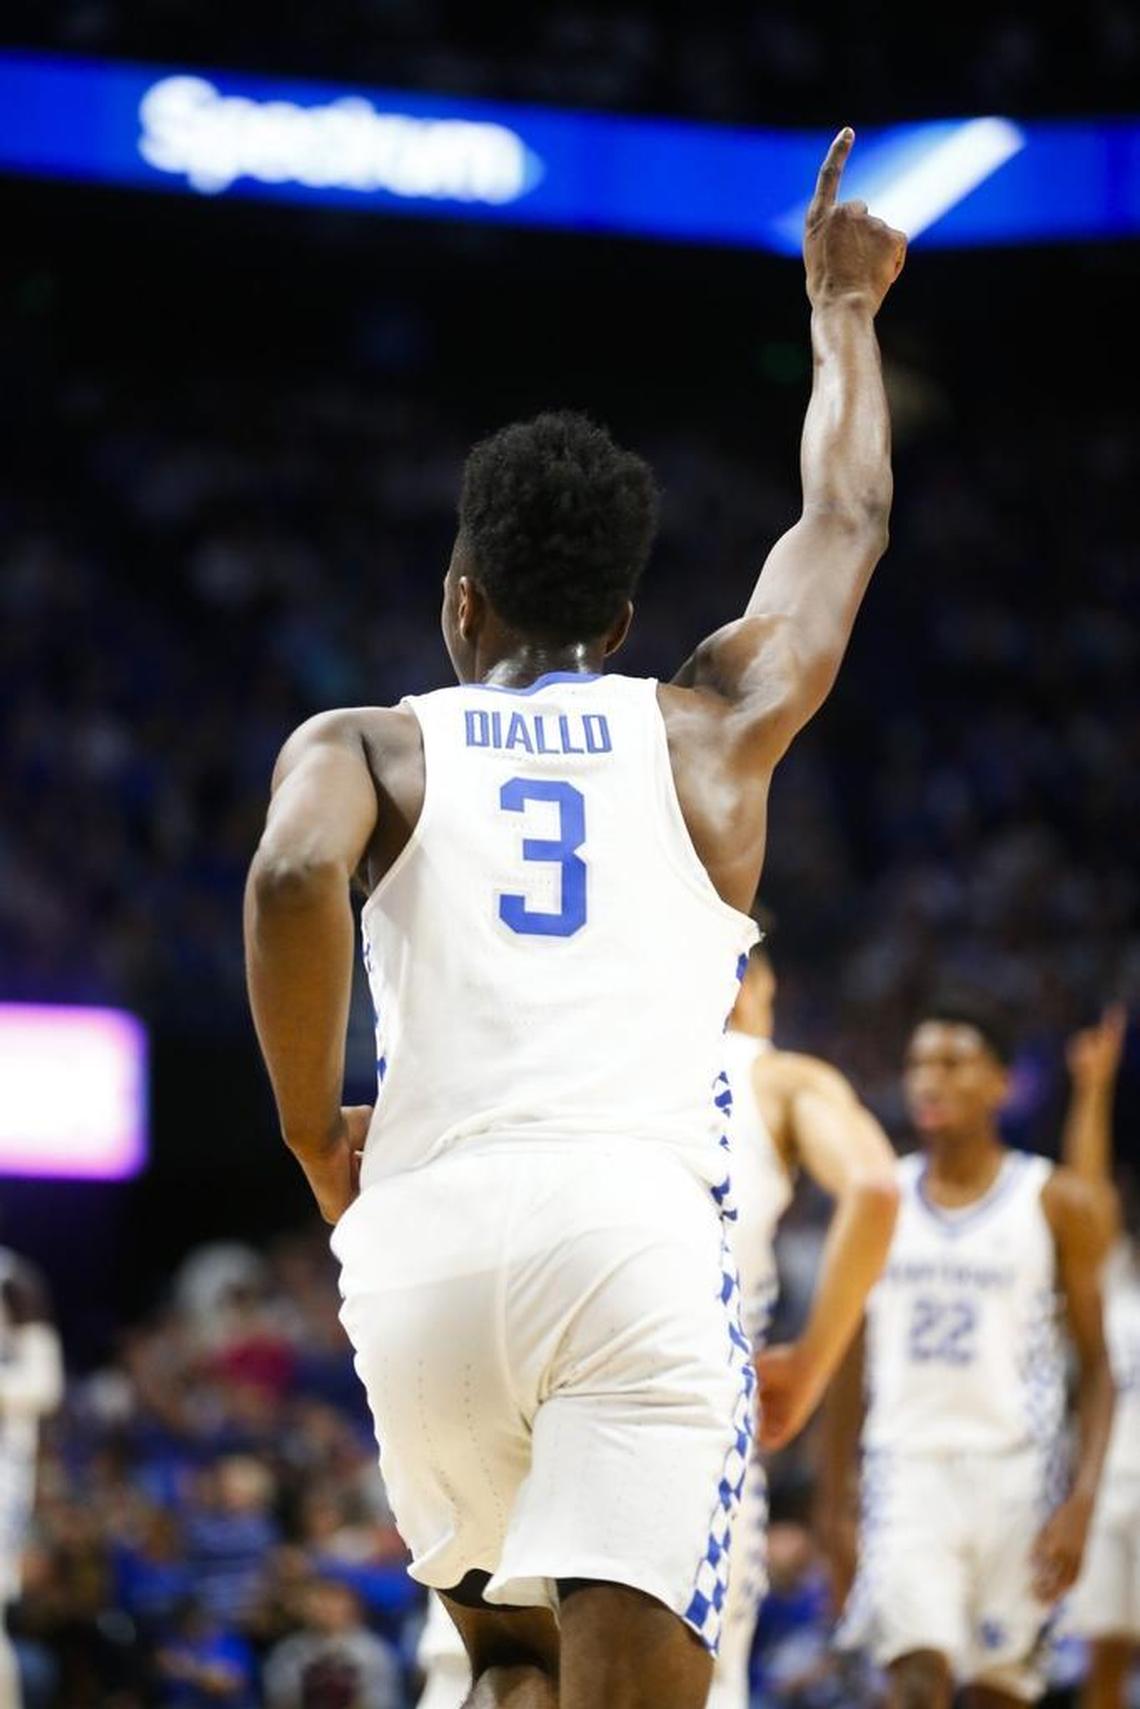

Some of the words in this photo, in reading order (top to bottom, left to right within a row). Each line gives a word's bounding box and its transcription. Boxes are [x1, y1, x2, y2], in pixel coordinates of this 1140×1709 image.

[465, 710, 612, 754] DIALLO
[499, 777, 587, 937] 3
[909, 1297, 977, 1366] 22
